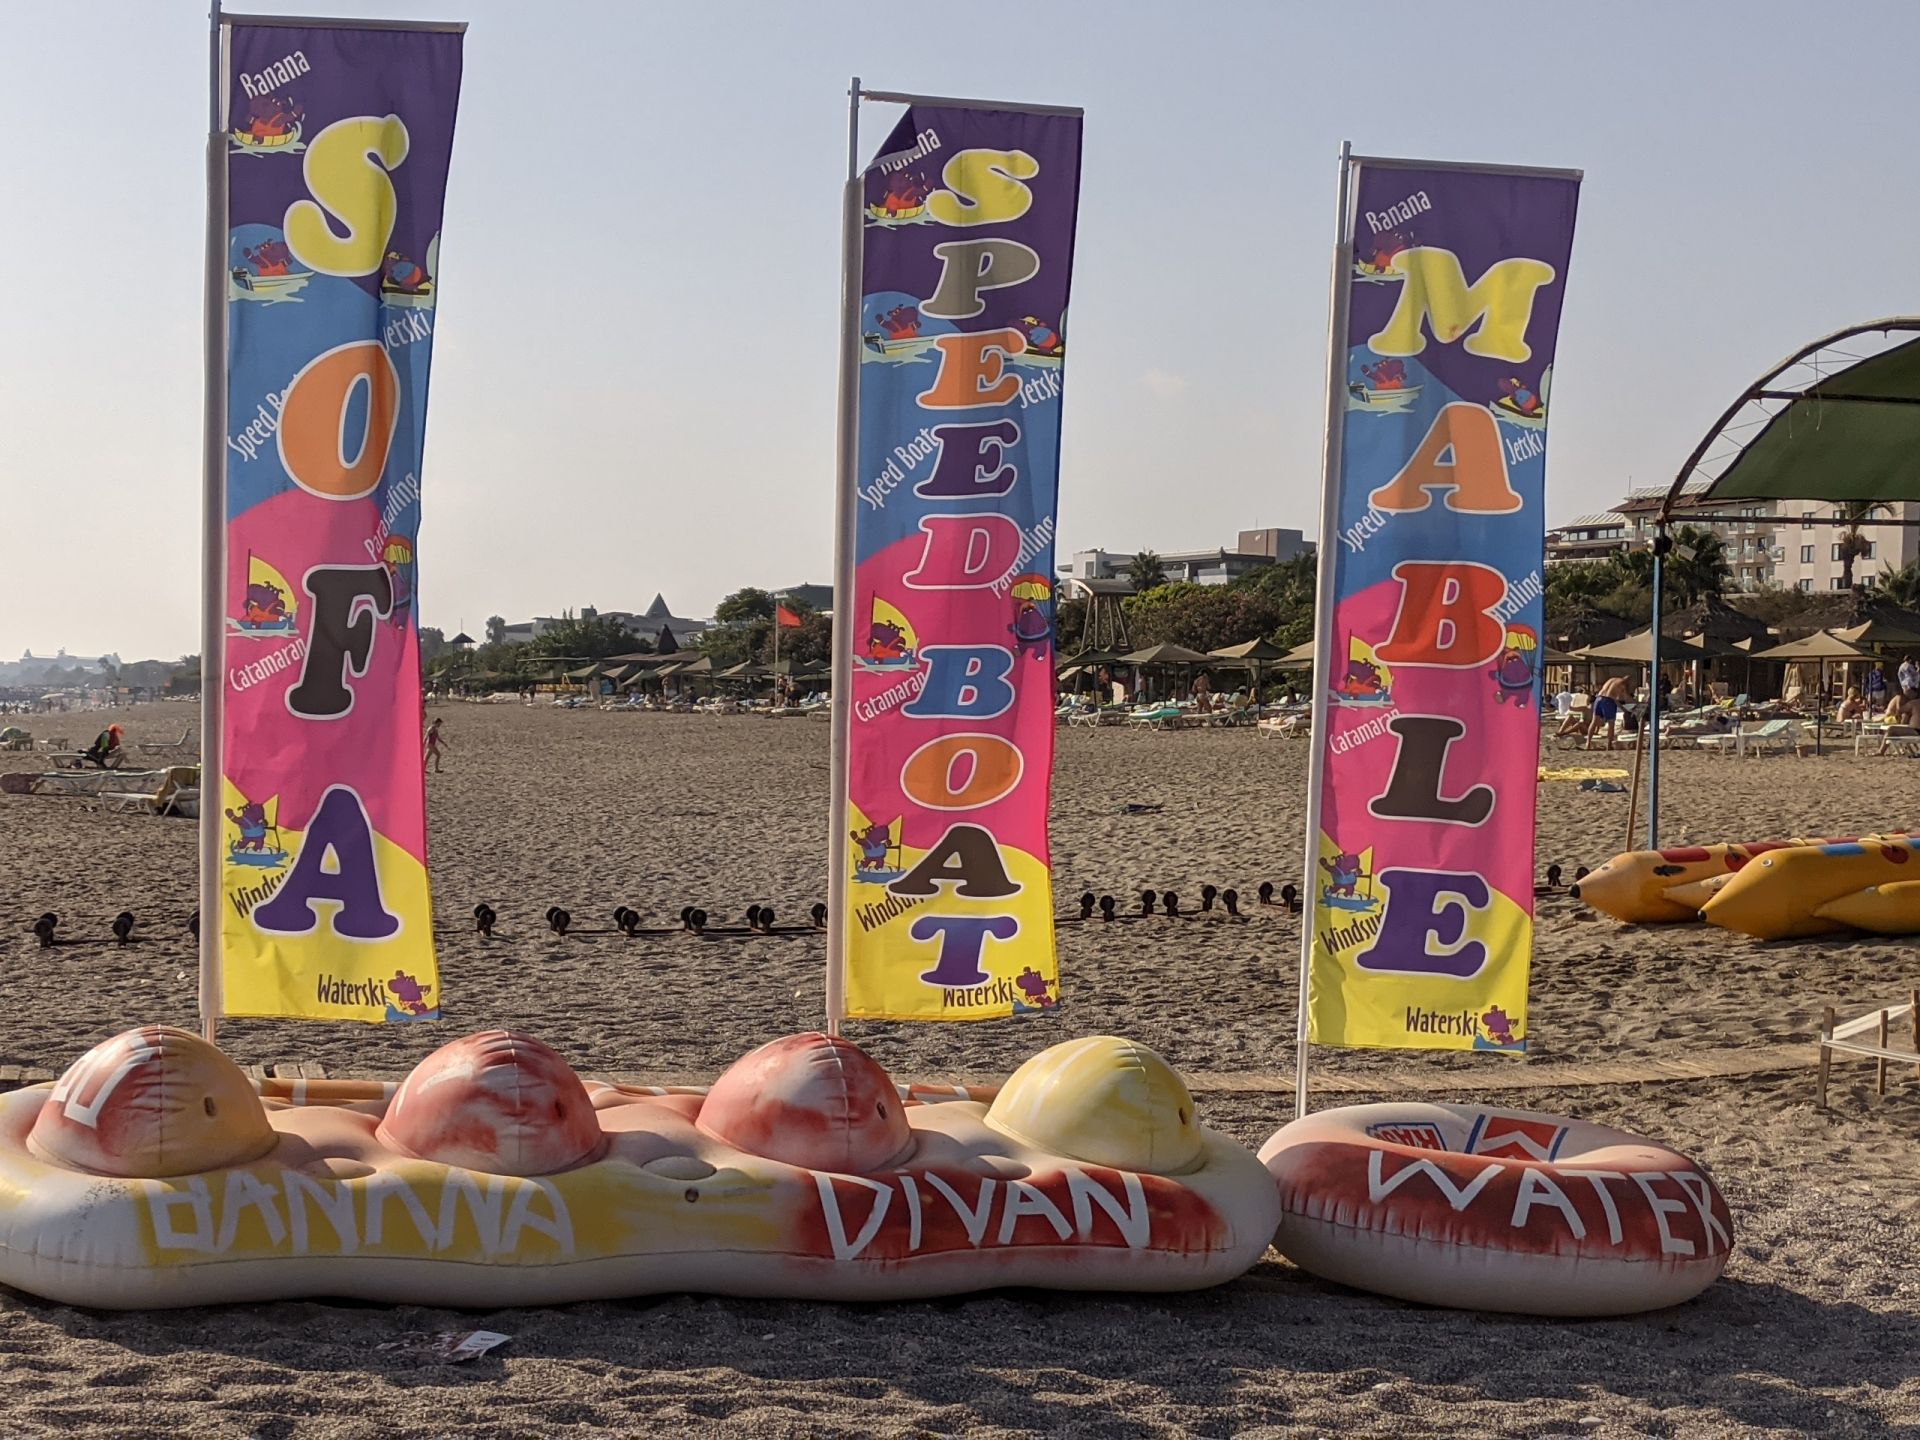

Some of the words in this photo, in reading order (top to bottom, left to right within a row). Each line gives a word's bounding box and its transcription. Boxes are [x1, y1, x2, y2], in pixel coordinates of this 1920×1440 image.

[240, 50, 311, 99] Banana
[1366, 190, 1432, 234] Banana
[1019, 367, 1061, 409] Jetski
[857, 458, 904, 510] Speed
[894, 427, 941, 470] Boat
[1505, 427, 1544, 465] Jetski
[364, 472, 420, 563] Parasailing
[229, 638, 306, 691] Catamaran
[855, 671, 926, 722] Catamaran
[855, 891, 924, 932] Windsu
[317, 973, 386, 1007] Waterski
[1406, 1006, 1479, 1036] Waterski
[144, 1167, 576, 1255] BANANA
[810, 1167, 1150, 1260] DIVAN
[1367, 1150, 1731, 1256] WATER
